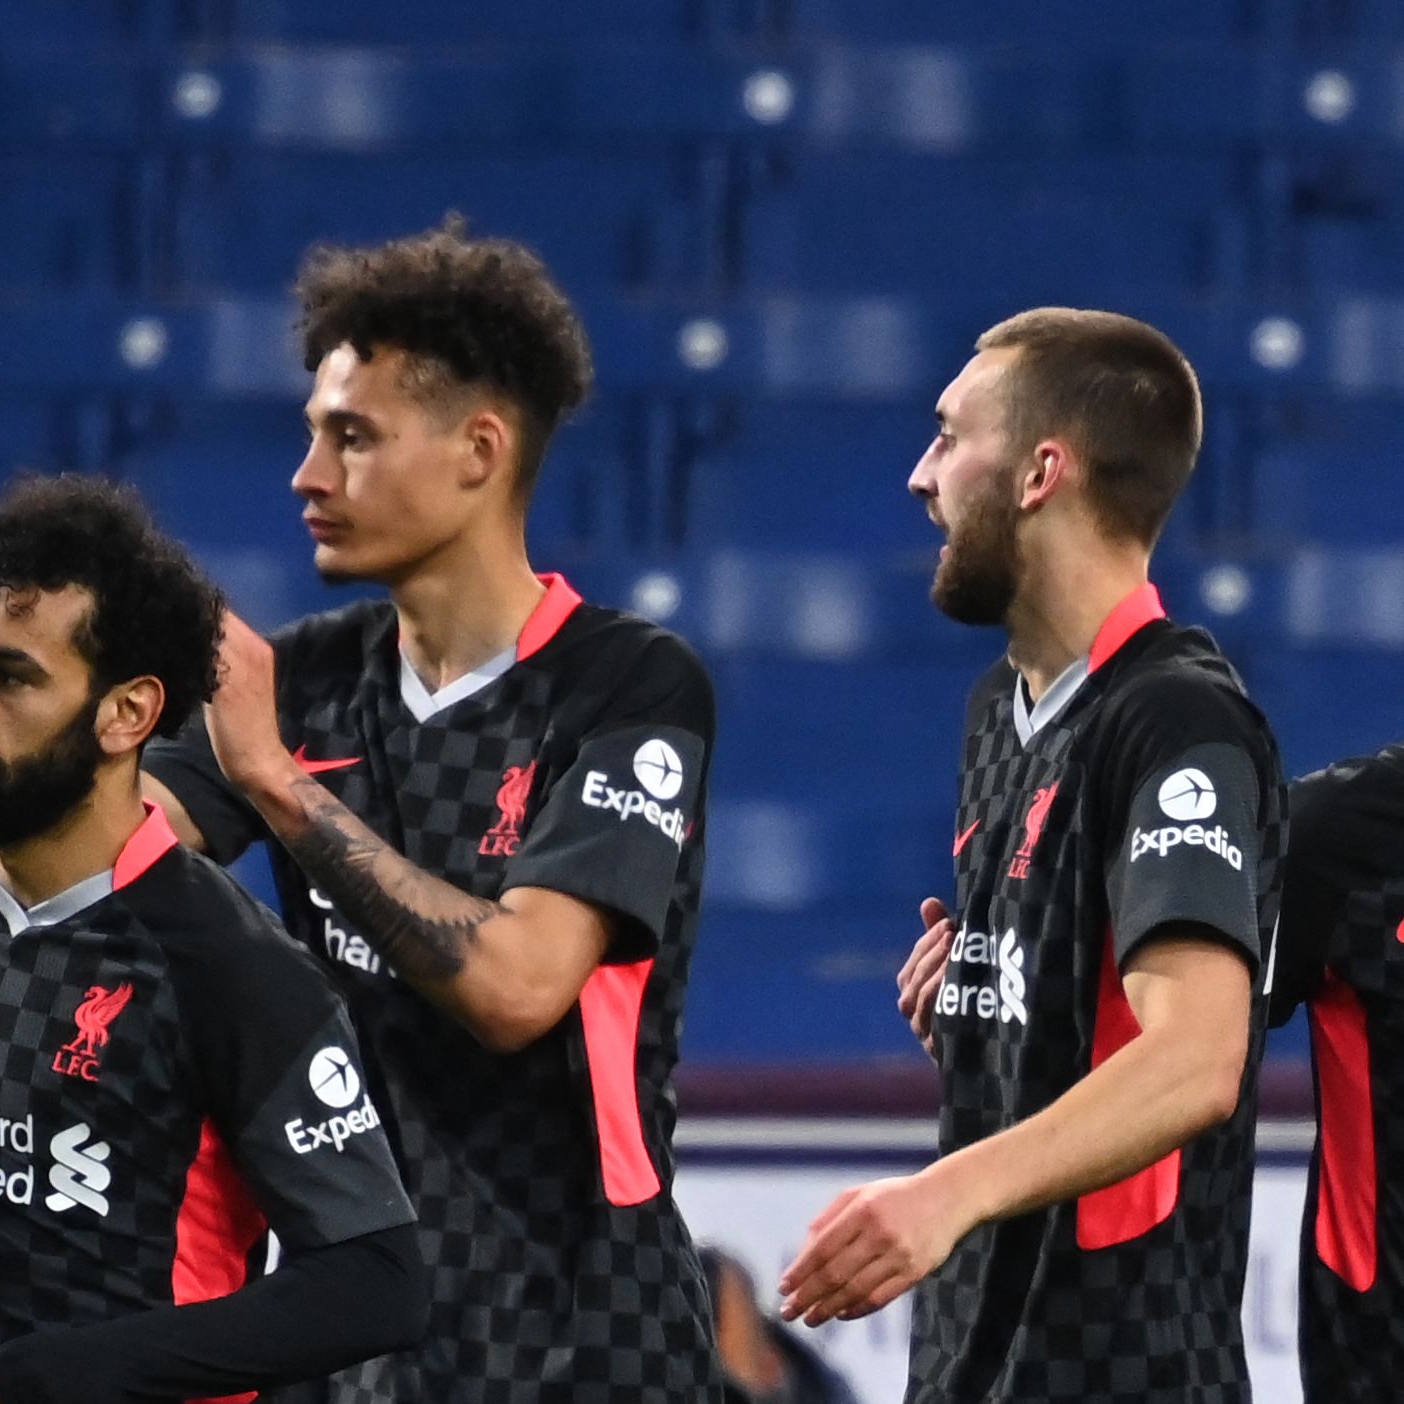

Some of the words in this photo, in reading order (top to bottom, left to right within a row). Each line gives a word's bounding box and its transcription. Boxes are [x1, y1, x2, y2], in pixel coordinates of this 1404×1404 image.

[479, 835, 520, 856] LFC
[1131, 824, 1242, 871] Expedia
[51, 1051, 101, 1083] LFC
